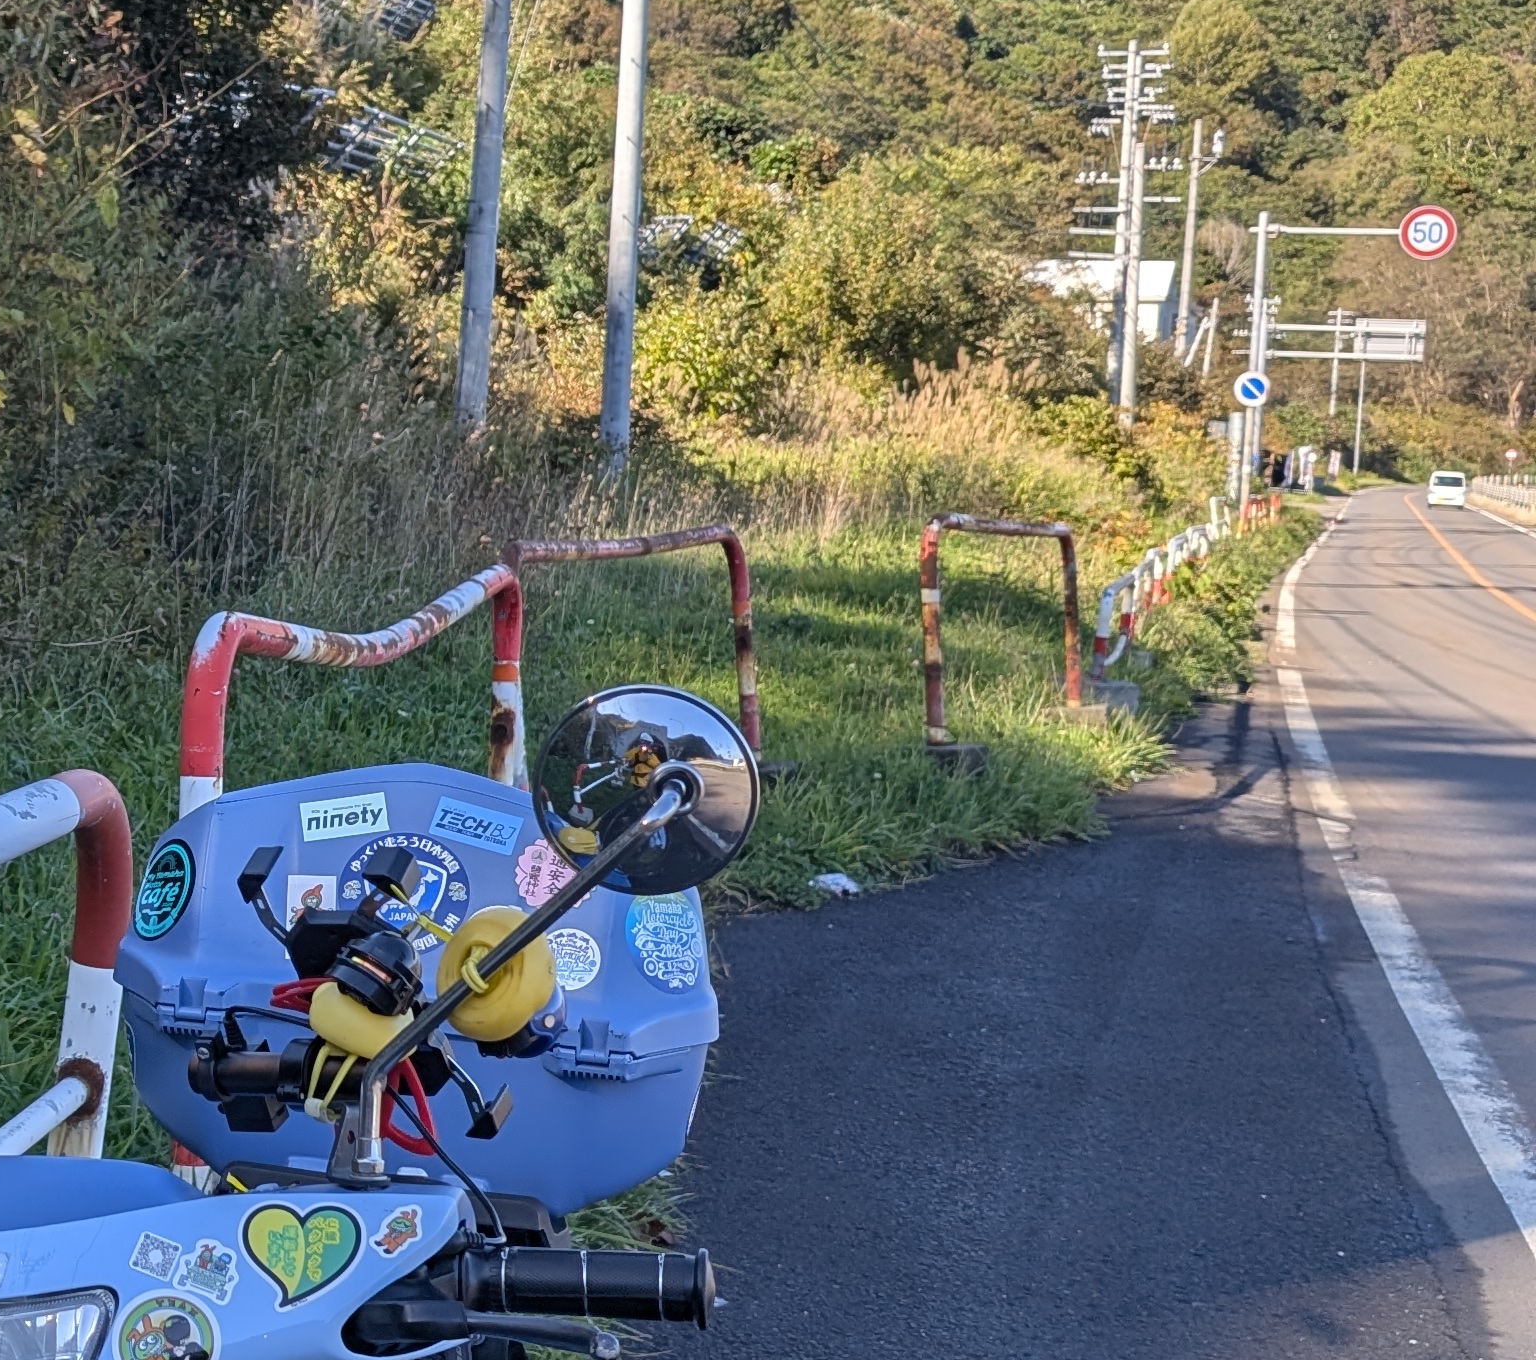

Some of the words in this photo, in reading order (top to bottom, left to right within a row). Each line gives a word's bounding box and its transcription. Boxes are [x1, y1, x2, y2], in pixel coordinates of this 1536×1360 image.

[1412, 221, 1444, 244] 50
[306, 806, 384, 831] ninety
[648, 900, 683, 914] Yamaha
[636, 908, 695, 929] Motorcycle
[651, 926, 686, 944] Day
[660, 944, 683, 957] 2023
